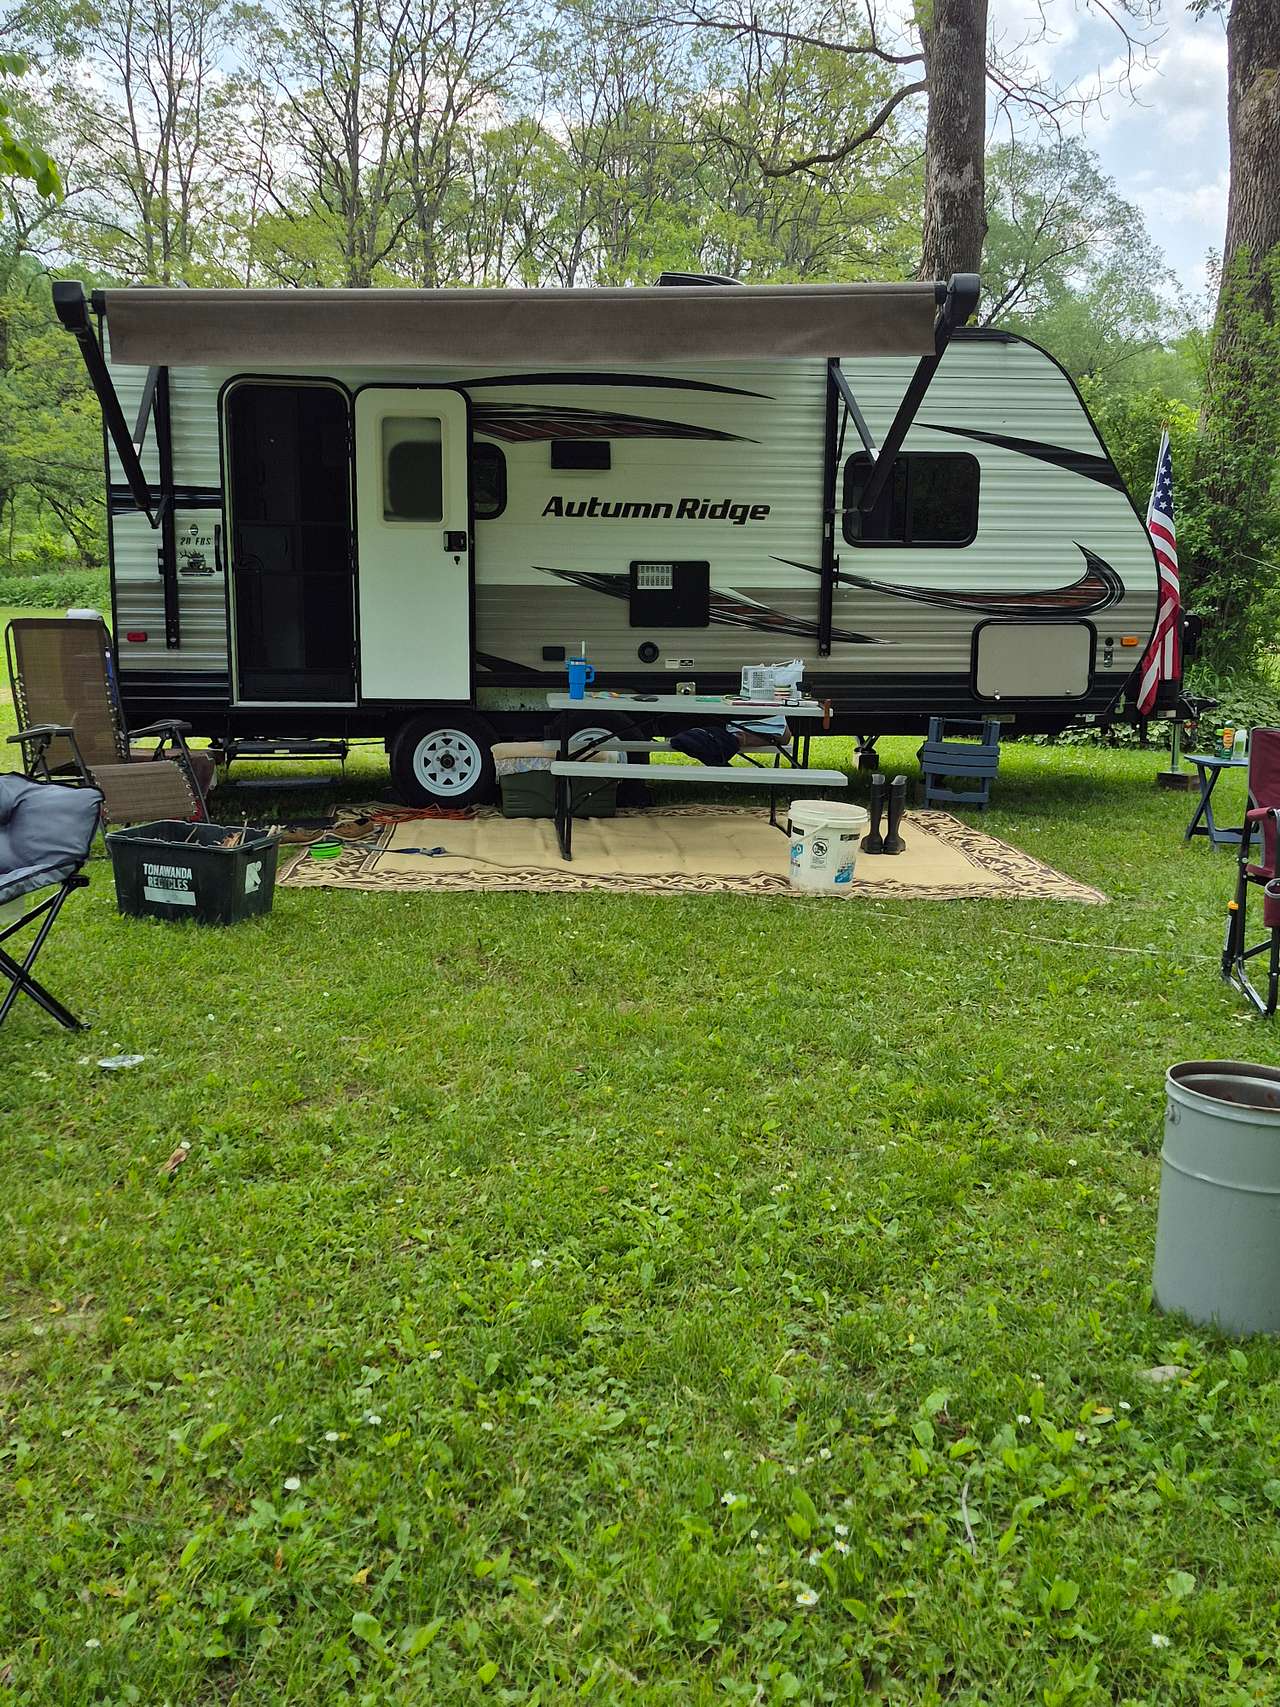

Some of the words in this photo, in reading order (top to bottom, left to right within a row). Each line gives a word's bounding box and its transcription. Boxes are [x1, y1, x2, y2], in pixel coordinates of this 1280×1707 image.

[541, 496, 674, 518] Autumn
[675, 498, 770, 526] Ridge
[143, 863, 193, 880] TONAWANDA
[148, 876, 189, 891] RECYCLES
